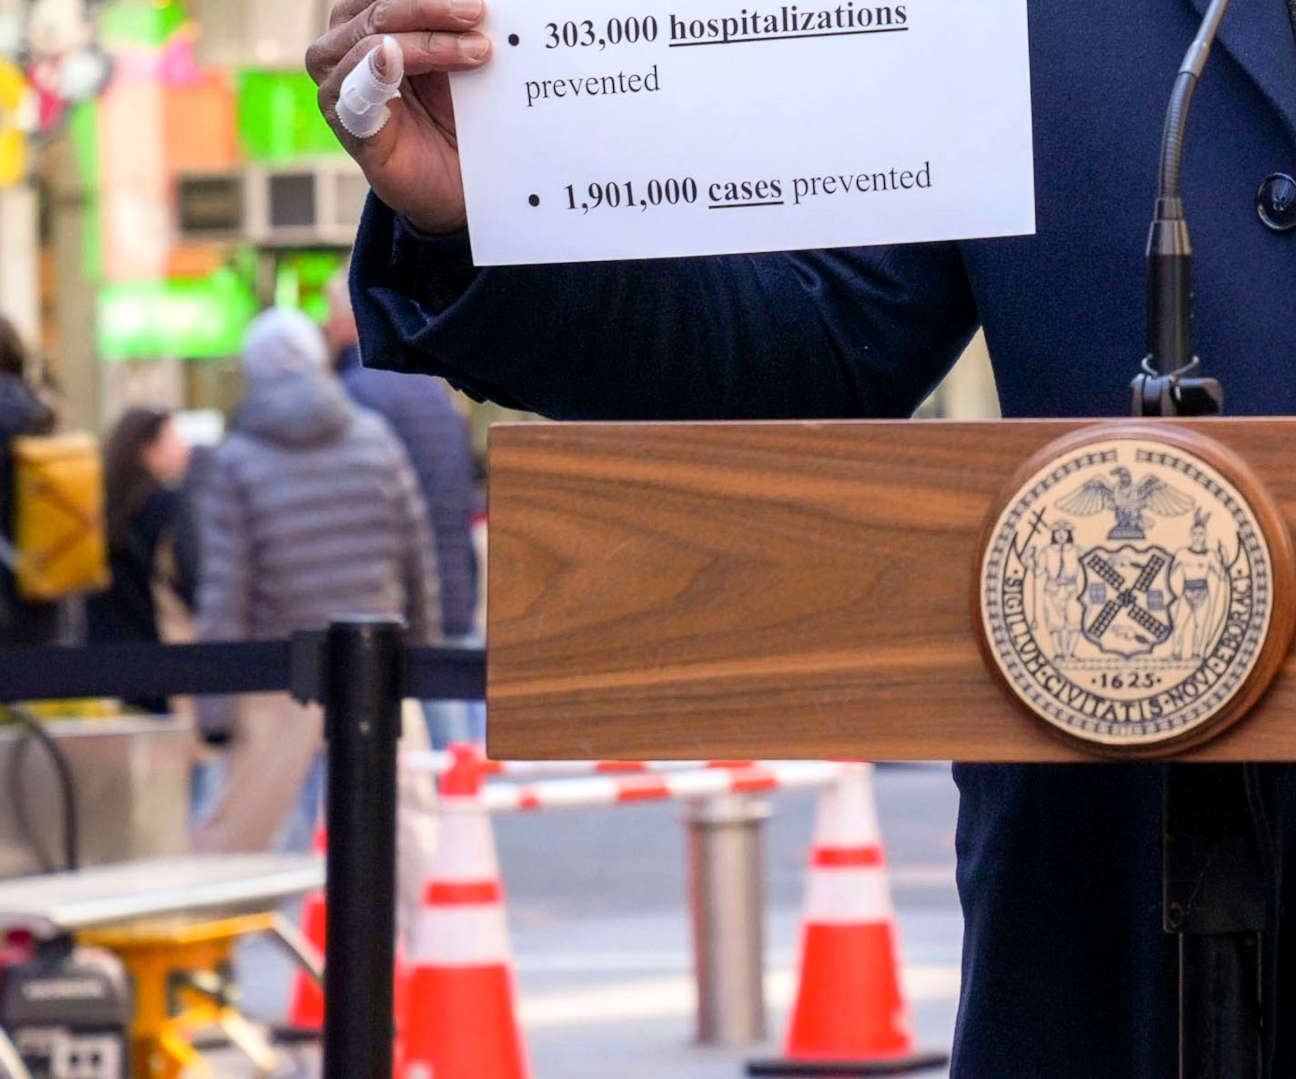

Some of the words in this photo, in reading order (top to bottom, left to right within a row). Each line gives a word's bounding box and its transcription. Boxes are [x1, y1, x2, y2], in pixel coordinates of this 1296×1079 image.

[544, 15, 658, 51] 303,000
[669, 1, 908, 44] hospitalizations
[525, 65, 661, 107] prevented
[565, 177, 698, 216] 1,901,000
[708, 176, 783, 203] cases
[792, 161, 933, 205] prevented
[1003, 577, 1050, 677] SIGILLUM
[1042, 673, 1164, 722] CIVITATIS
[1166, 658, 1222, 708] NOVI
[1101, 672, 1155, 690] 1625
